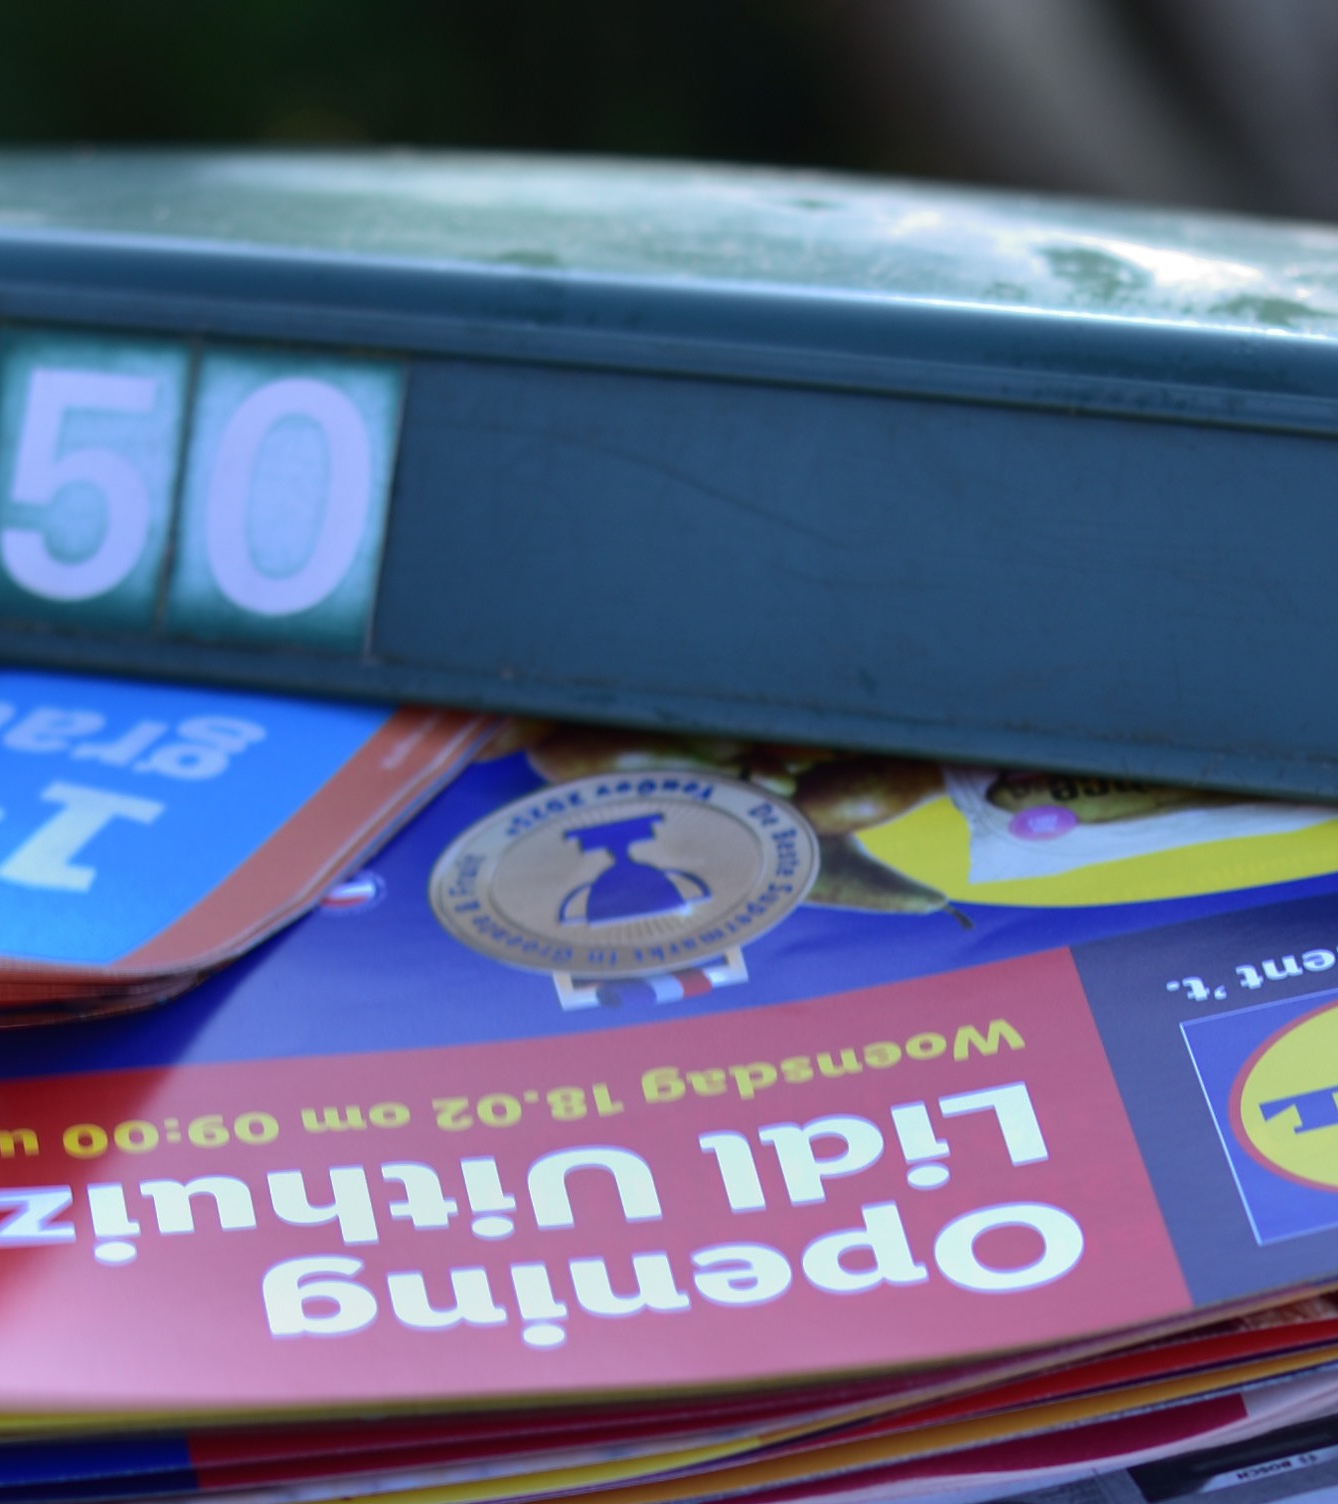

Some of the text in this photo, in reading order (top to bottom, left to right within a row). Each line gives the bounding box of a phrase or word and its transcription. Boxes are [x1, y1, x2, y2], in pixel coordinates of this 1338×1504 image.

[640, 1017, 1026, 1106] Woensdag
[61, 1112, 280, 1159] 09:00
[299, 1101, 412, 1134] om
[430, 1082, 625, 1133] 18.02
[697, 1080, 1049, 1213] Lidl
[261, 1200, 1085, 1351] Opening
